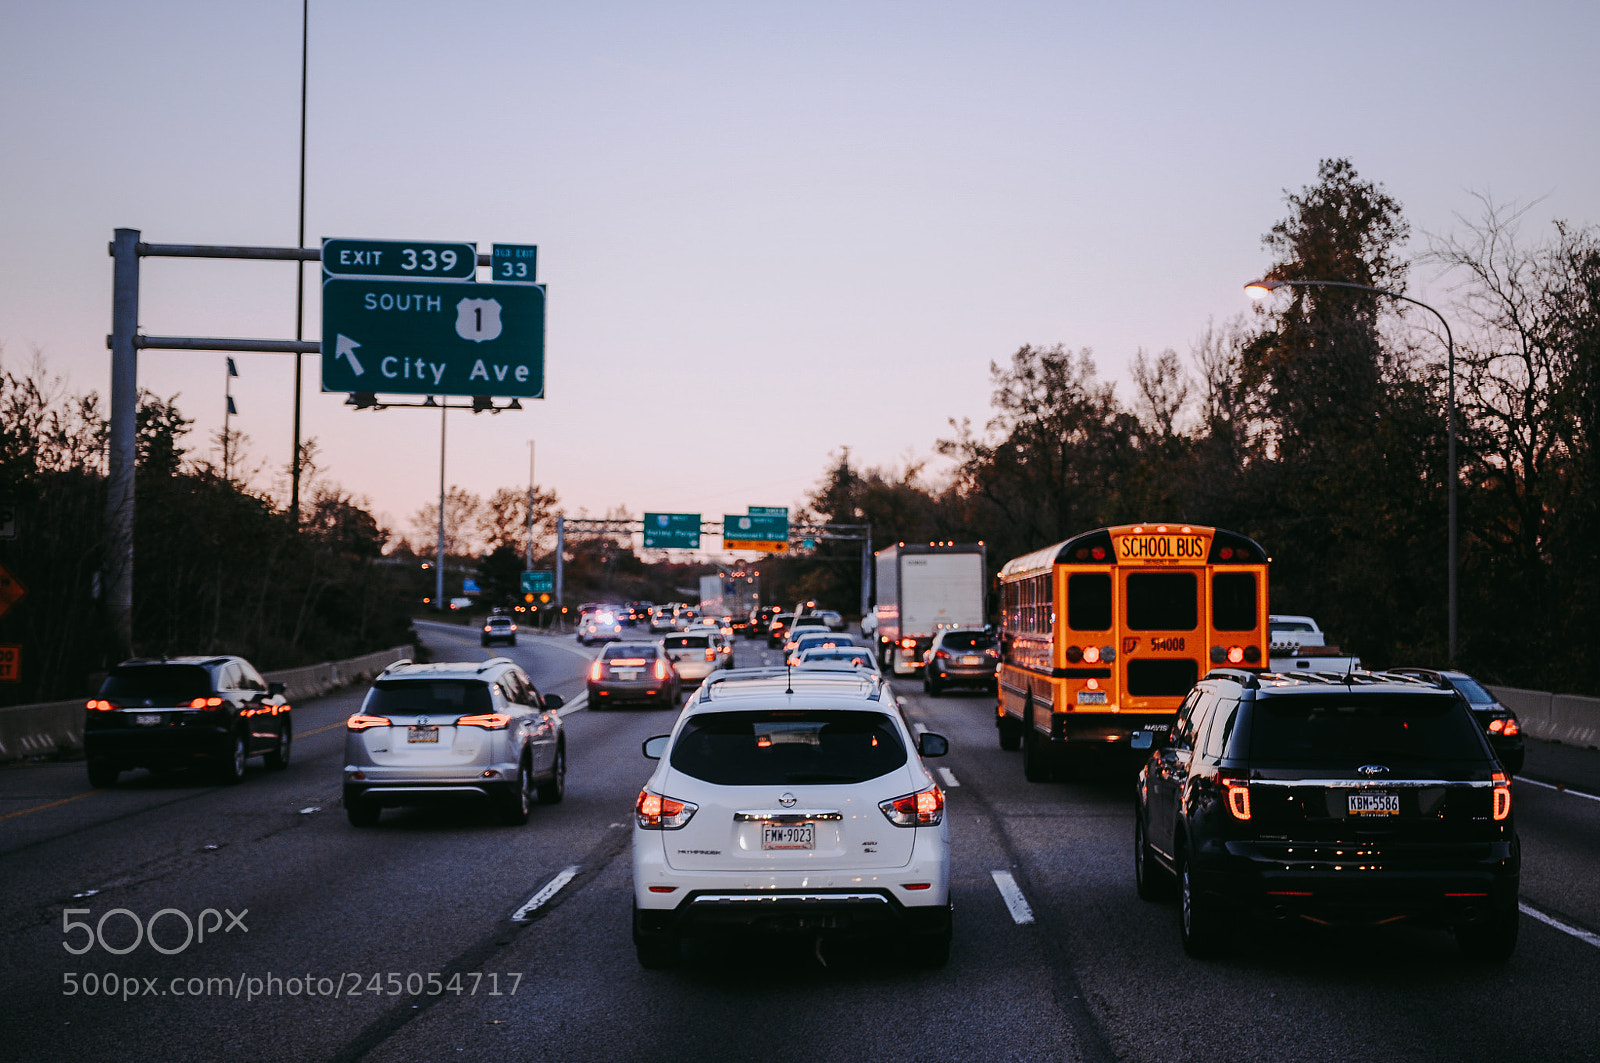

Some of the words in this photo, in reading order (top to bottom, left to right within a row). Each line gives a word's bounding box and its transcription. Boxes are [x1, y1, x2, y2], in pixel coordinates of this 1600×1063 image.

[340, 250, 383, 266] EXIT
[401, 248, 458, 271] 339
[501, 261, 528, 278] 33
[364, 293, 441, 312] SOUTH
[473, 307, 482, 332] 1
[380, 356, 446, 386] City
[469, 359, 530, 382] Ave
[1122, 537, 1174, 557] SCHOOL
[1177, 537, 1203, 557] BUS
